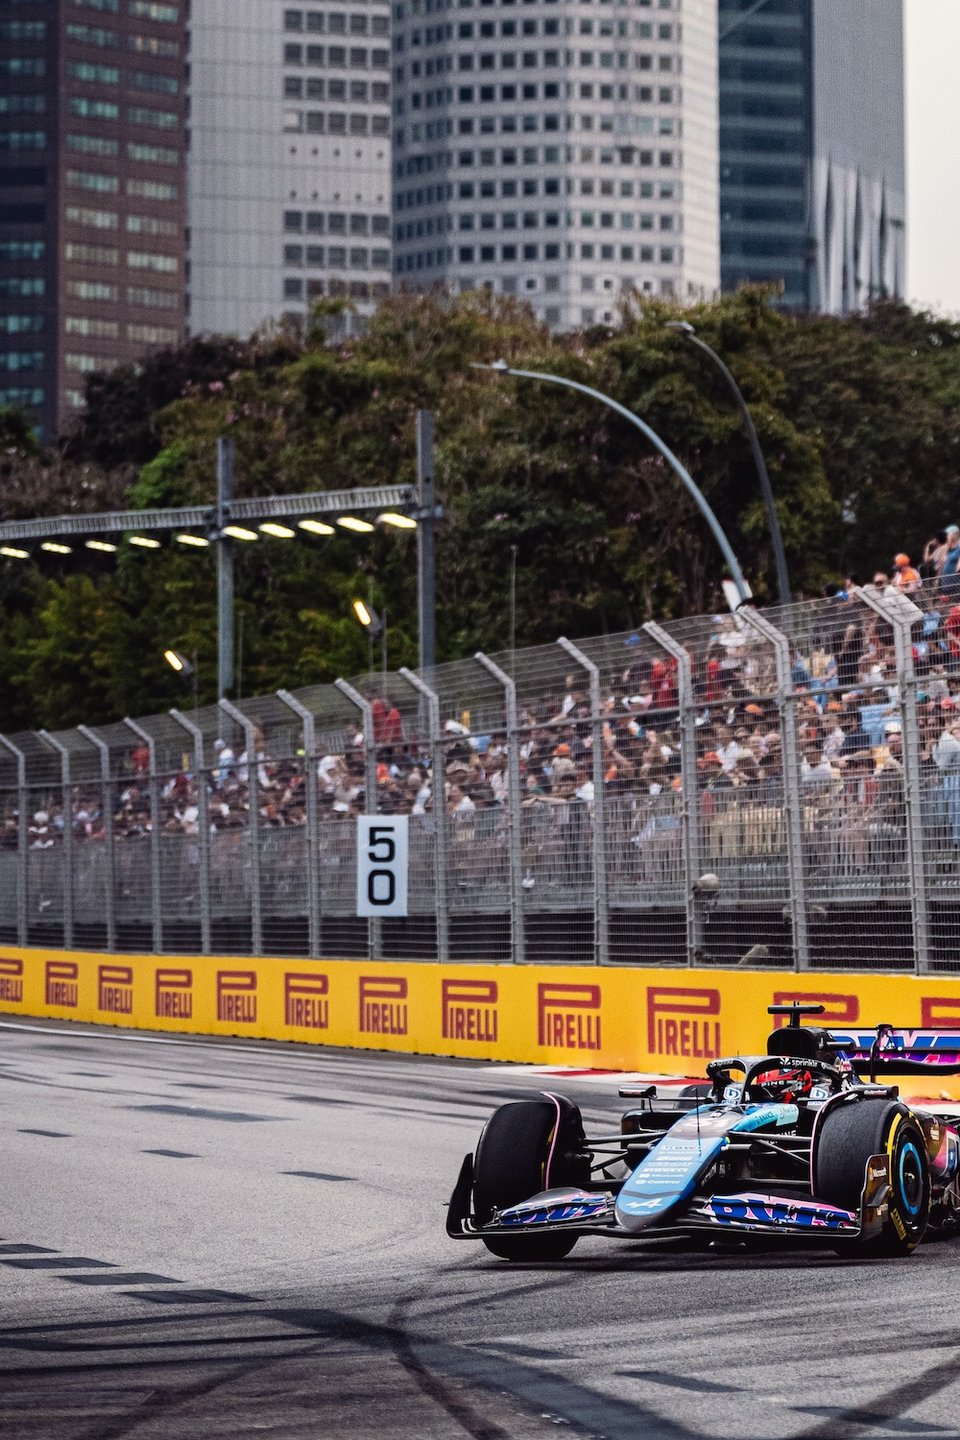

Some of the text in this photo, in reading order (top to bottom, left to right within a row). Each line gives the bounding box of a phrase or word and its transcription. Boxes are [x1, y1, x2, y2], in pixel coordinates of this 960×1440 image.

[45, 961, 78, 1008] PIRELLI
[98, 965, 133, 1014] PIRELLI
[156, 969, 193, 1020] PIRELLI
[217, 971, 257, 1027] PIRELLI
[285, 973, 328, 1029] PIRELLI
[359, 976, 408, 1035] PIRELLI
[442, 979, 498, 1042] PIRELLI
[538, 983, 601, 1050] PIRELLI
[647, 987, 720, 1059] PIRELLI
